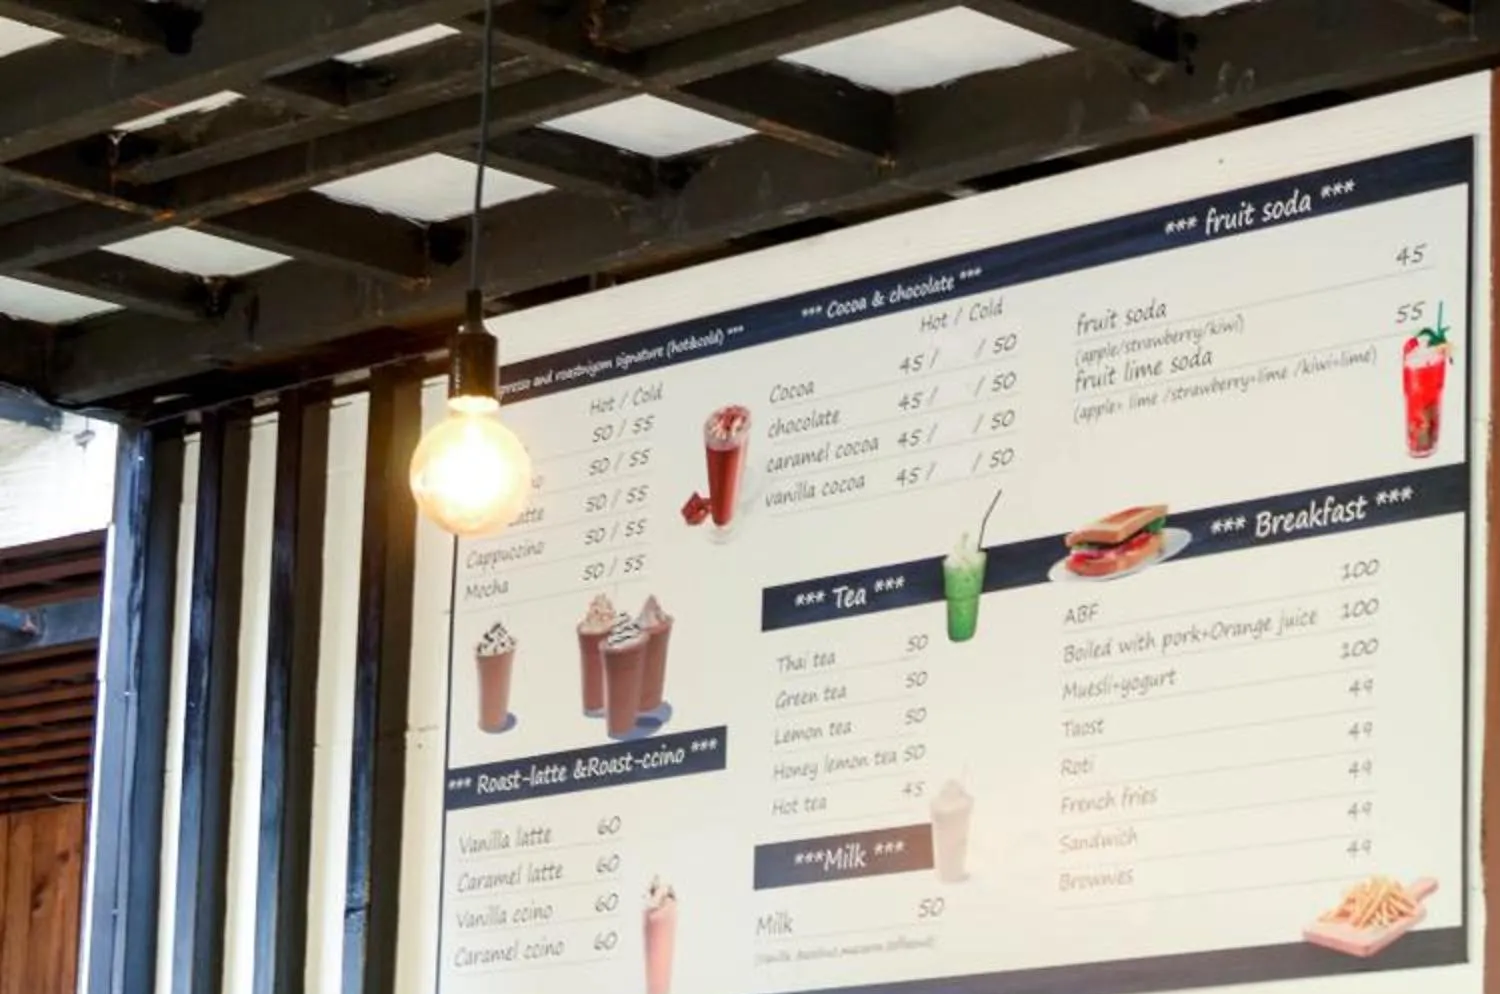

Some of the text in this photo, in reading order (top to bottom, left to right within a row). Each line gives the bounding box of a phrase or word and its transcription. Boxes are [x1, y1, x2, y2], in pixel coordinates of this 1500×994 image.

[1205, 188, 1312, 236] fruit soda
[827, 276, 955, 318] Cocoa & chocolate
[1077, 243, 1426, 336] fruit soda 45
[921, 314, 948, 333] Hot
[969, 296, 1004, 322] Cold
[533, 370, 552, 385] and
[616, 345, 664, 370] signature
[666, 327, 726, 358] (hot&cold)
[1075, 301, 1424, 393] fruit lime soda 55
[769, 380, 815, 404] Cocoa
[899, 354, 924, 374] 45
[993, 333, 1017, 354] 50
[590, 400, 615, 416] Hot
[632, 382, 663, 405] Cold
[768, 408, 841, 439] chocolate
[899, 391, 923, 411] 45
[992, 371, 1017, 393] 50
[592, 424, 613, 443] 50
[632, 415, 655, 435] 55
[766, 439, 830, 473] caramel
[835, 437, 879, 459] cocoa
[897, 429, 922, 449] 45
[991, 409, 1015, 430] 50
[589, 457, 611, 476] 50
[629, 448, 651, 467] 55
[765, 476, 815, 507] vanilla
[821, 474, 865, 496] cocoa
[896, 467, 921, 487] 45
[989, 448, 1014, 469] 50
[585, 493, 607, 513] 50
[626, 485, 649, 504] 55
[1255, 495, 1368, 539] Breakfast
[466, 541, 546, 571] Cappuccino
[584, 527, 606, 546] 50
[624, 518, 647, 538] 55
[464, 578, 509, 600] Mocha
[582, 562, 605, 581] 50
[623, 554, 646, 574] 55
[1064, 558, 1380, 625] ABF 100
[832, 585, 867, 609] Tea
[1063, 638, 1111, 664] Boiled
[1119, 630, 1155, 655] with
[1277, 609, 1318, 636] juice
[1341, 598, 1380, 620] 100
[1340, 638, 1379, 660] 100
[777, 634, 928, 673] Thai tea 50
[775, 671, 928, 709] Green tea 50
[1348, 678, 1374, 697] 49
[774, 707, 927, 745] Lemon tea 50
[1348, 721, 1373, 740] 49
[477, 762, 566, 795] Roast-latte
[773, 744, 926, 781] Honey lemon tea 50
[772, 781, 925, 816] Hot tea 45
[1061, 760, 1373, 815] French fries 49
[459, 815, 622, 854] Vanilla latte 60
[1059, 801, 1372, 855] Sandwich 49
[1346, 839, 1371, 858] 49
[457, 854, 620, 893] Caramel latte 60
[457, 893, 619, 929] Vanilla ccino 60
[756, 897, 945, 936] Milk 50
[454, 931, 618, 968] Caramel ccino 60
